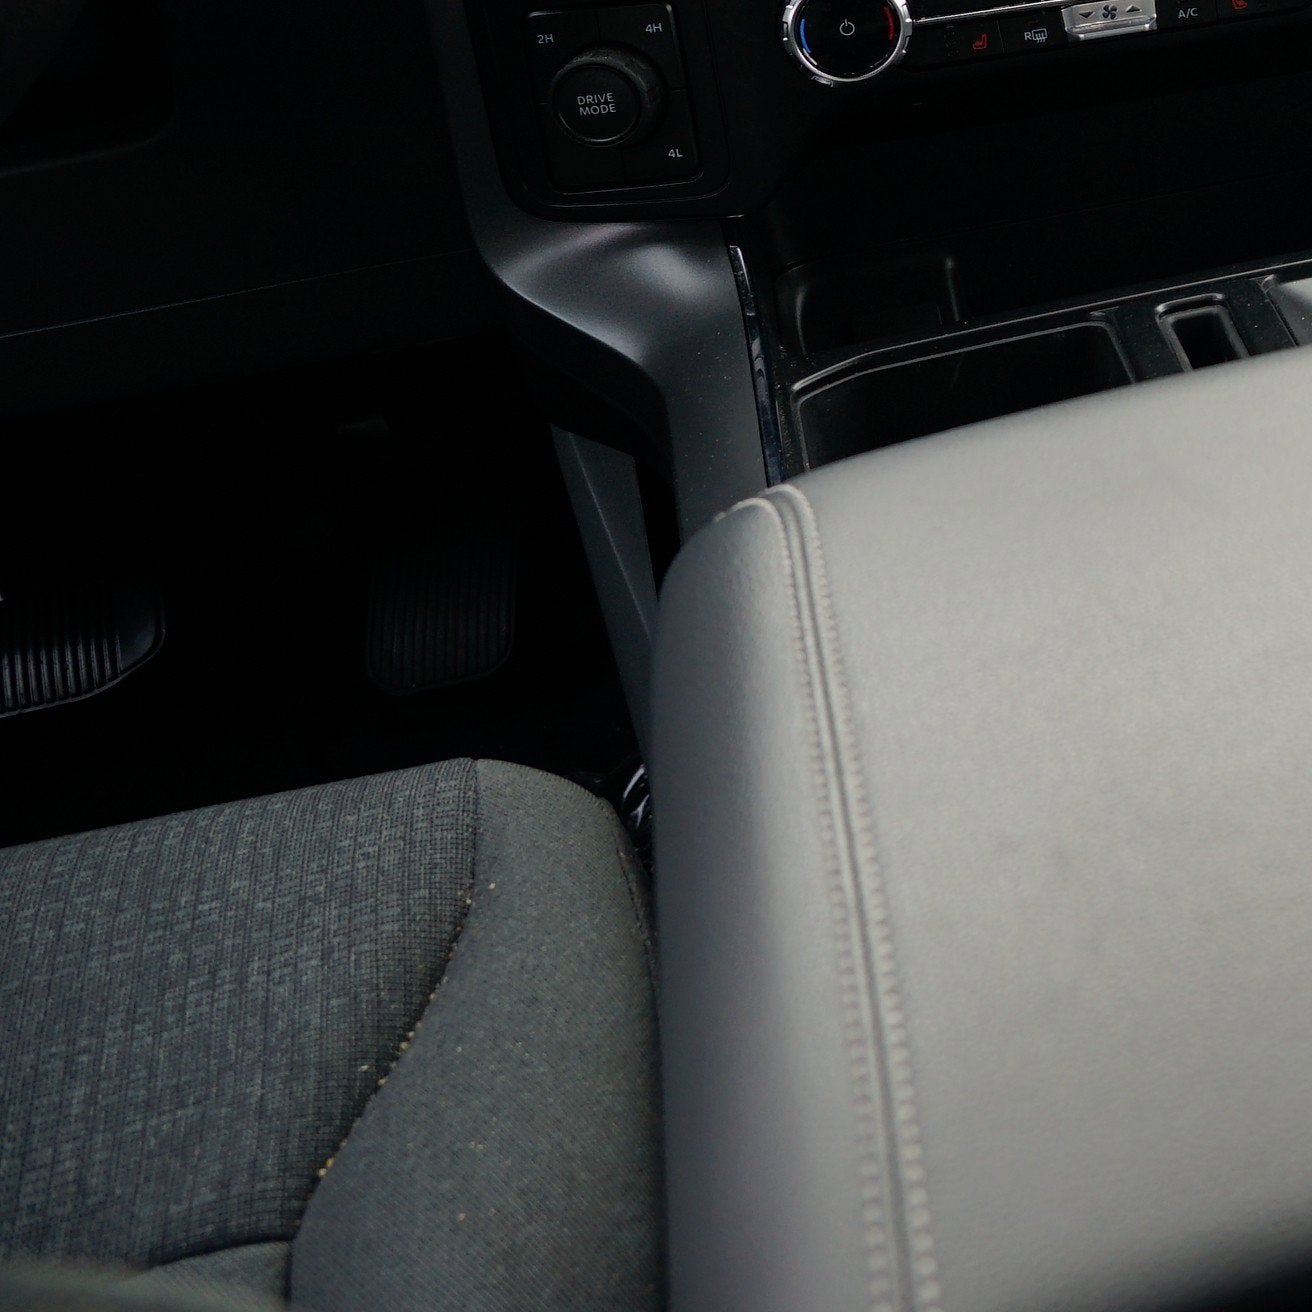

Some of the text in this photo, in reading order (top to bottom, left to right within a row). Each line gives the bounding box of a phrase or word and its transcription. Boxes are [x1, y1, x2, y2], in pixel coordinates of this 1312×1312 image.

[1178, 6, 1198, 19] A/C
[645, 21, 663, 34] 4H
[537, 33, 554, 45] 2H
[577, 92, 615, 106] DRIVE
[579, 103, 617, 117] MODE
[668, 147, 684, 159] 4L
